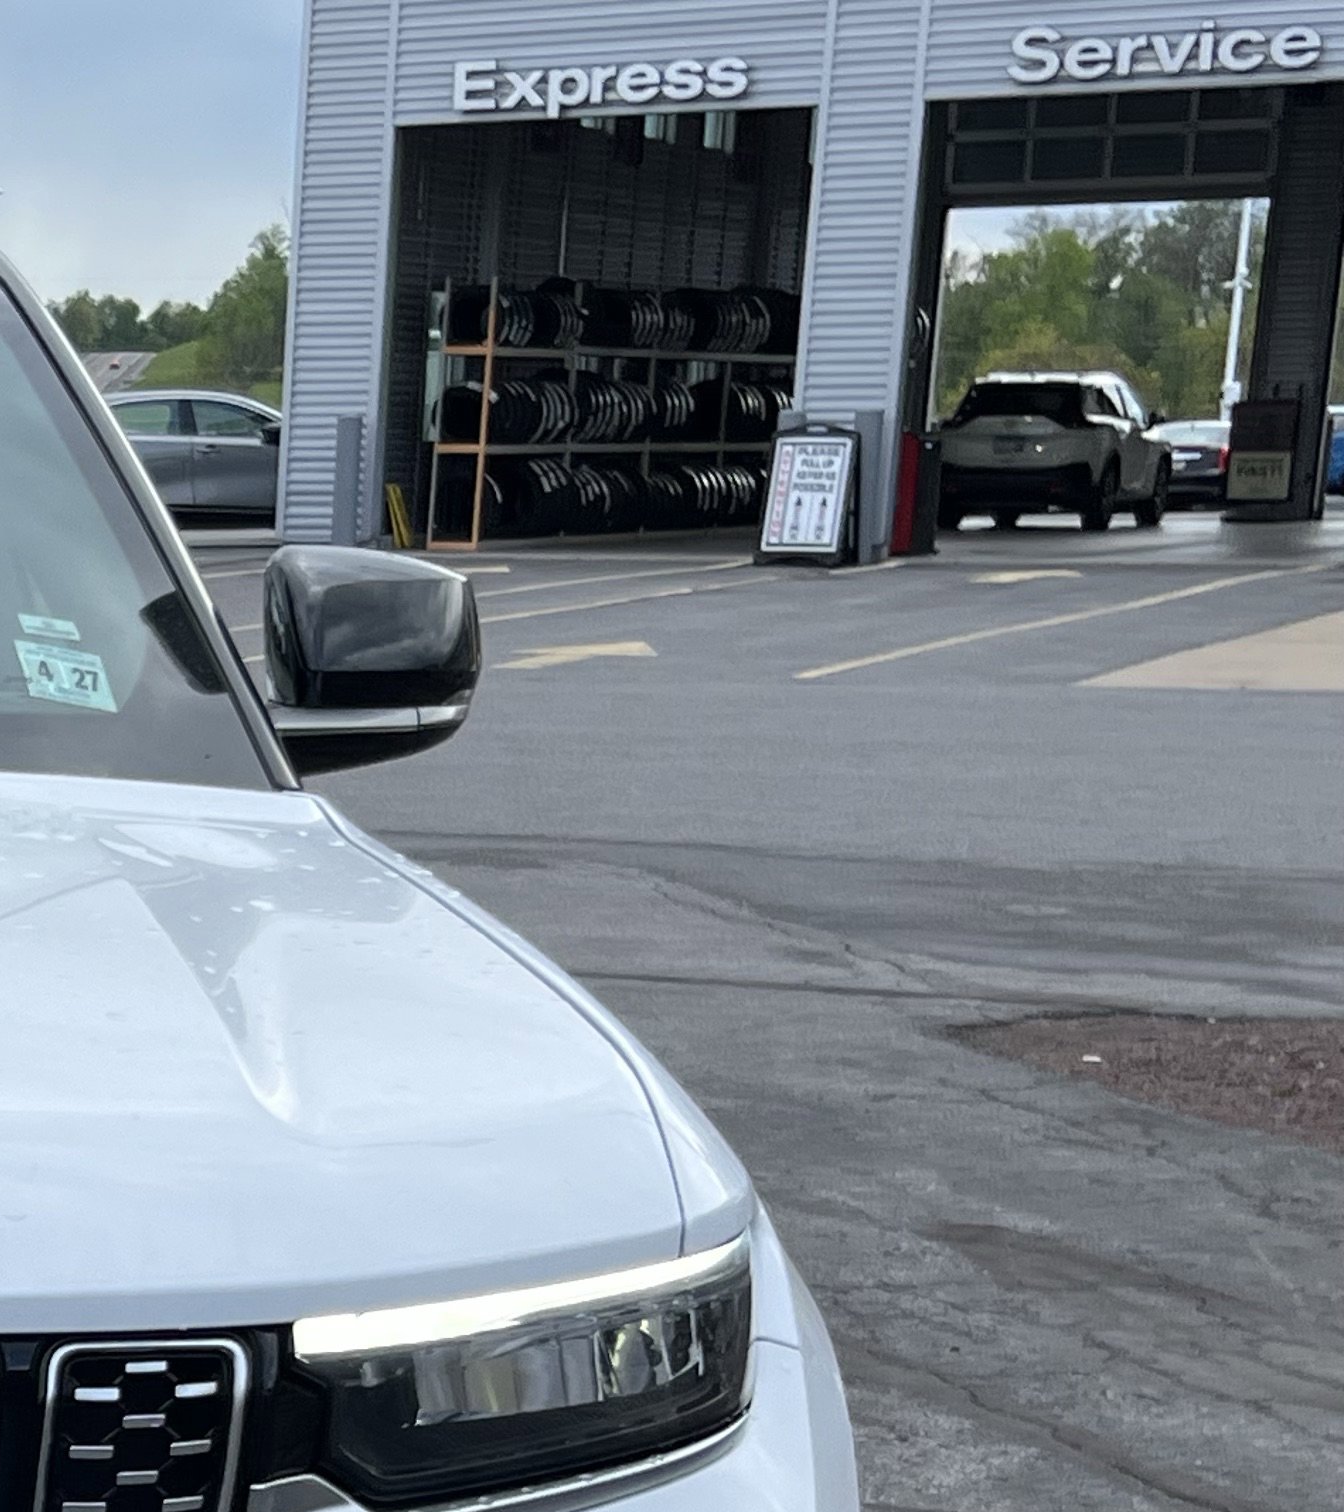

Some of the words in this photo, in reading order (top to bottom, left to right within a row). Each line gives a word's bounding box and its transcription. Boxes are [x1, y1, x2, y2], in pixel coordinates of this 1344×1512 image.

[453, 57, 750, 119] Express
[1006, 19, 1322, 84] Service
[38, 660, 54, 682] 4
[72, 667, 98, 692] 27
